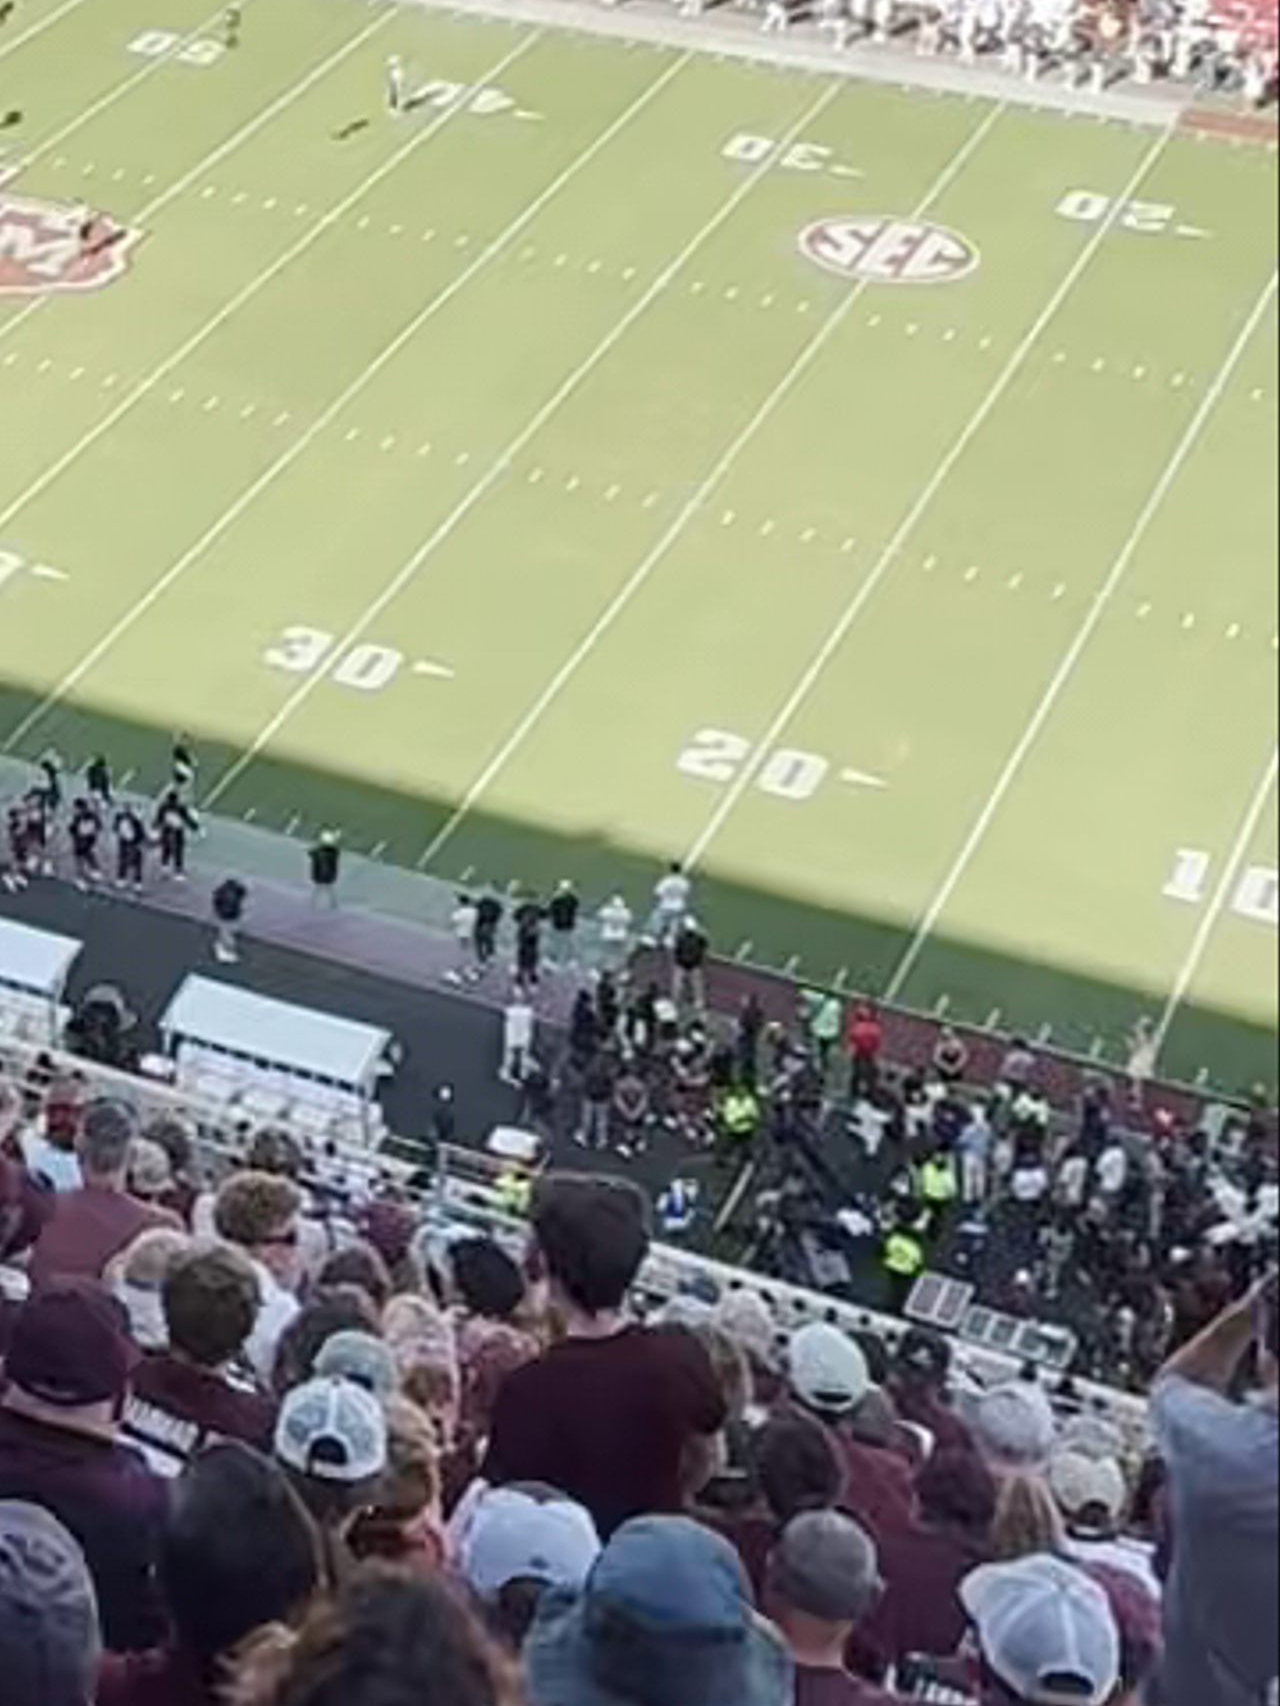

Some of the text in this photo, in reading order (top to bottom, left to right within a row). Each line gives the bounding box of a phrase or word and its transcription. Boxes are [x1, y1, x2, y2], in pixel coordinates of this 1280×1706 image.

[816, 219, 969, 279] SEC
[262, 626, 405, 690] 30
[675, 727, 830, 801] 20
[1161, 846, 1278, 925] 10
